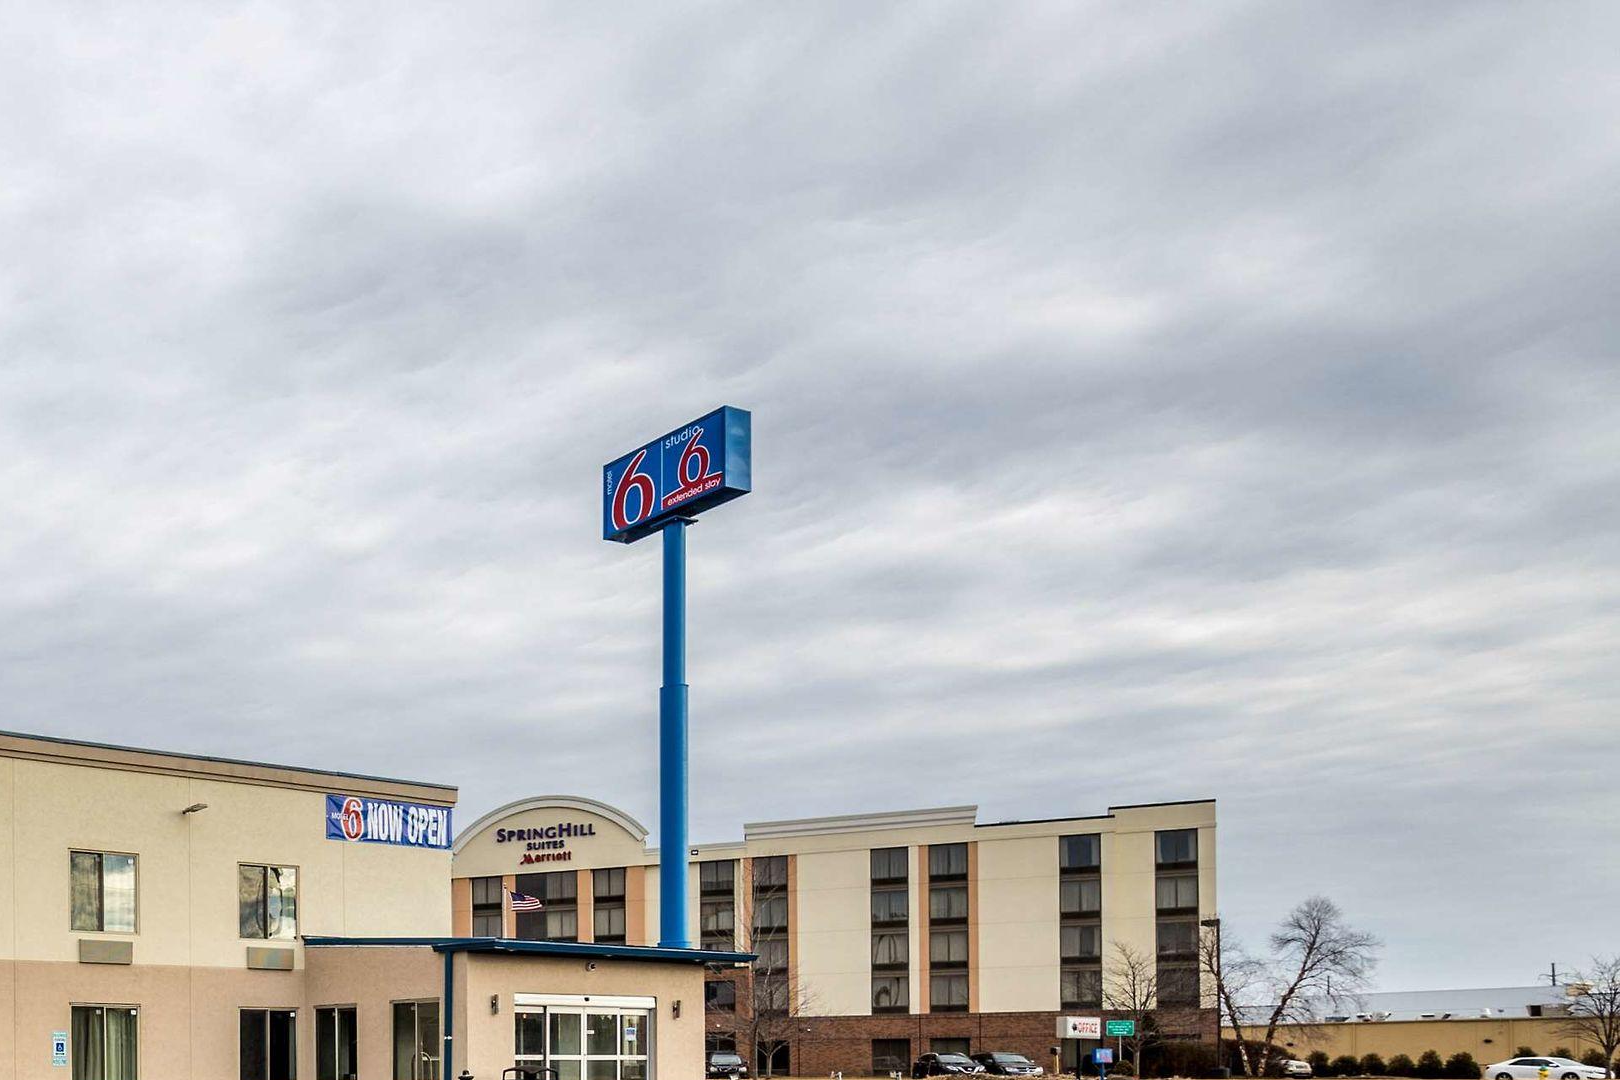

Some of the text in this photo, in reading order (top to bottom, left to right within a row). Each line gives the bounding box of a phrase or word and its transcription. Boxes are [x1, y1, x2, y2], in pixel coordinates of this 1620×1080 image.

[665, 425, 701, 449] studio
[677, 428, 711, 488] 6
[612, 449, 656, 530] 6
[667, 477, 722, 506] extended stay
[342, 797, 364, 841] 6
[367, 802, 404, 842] NOW
[407, 806, 448, 846] OPEN
[519, 850, 572, 865] Marriott
[526, 840, 565, 851] SUITES
